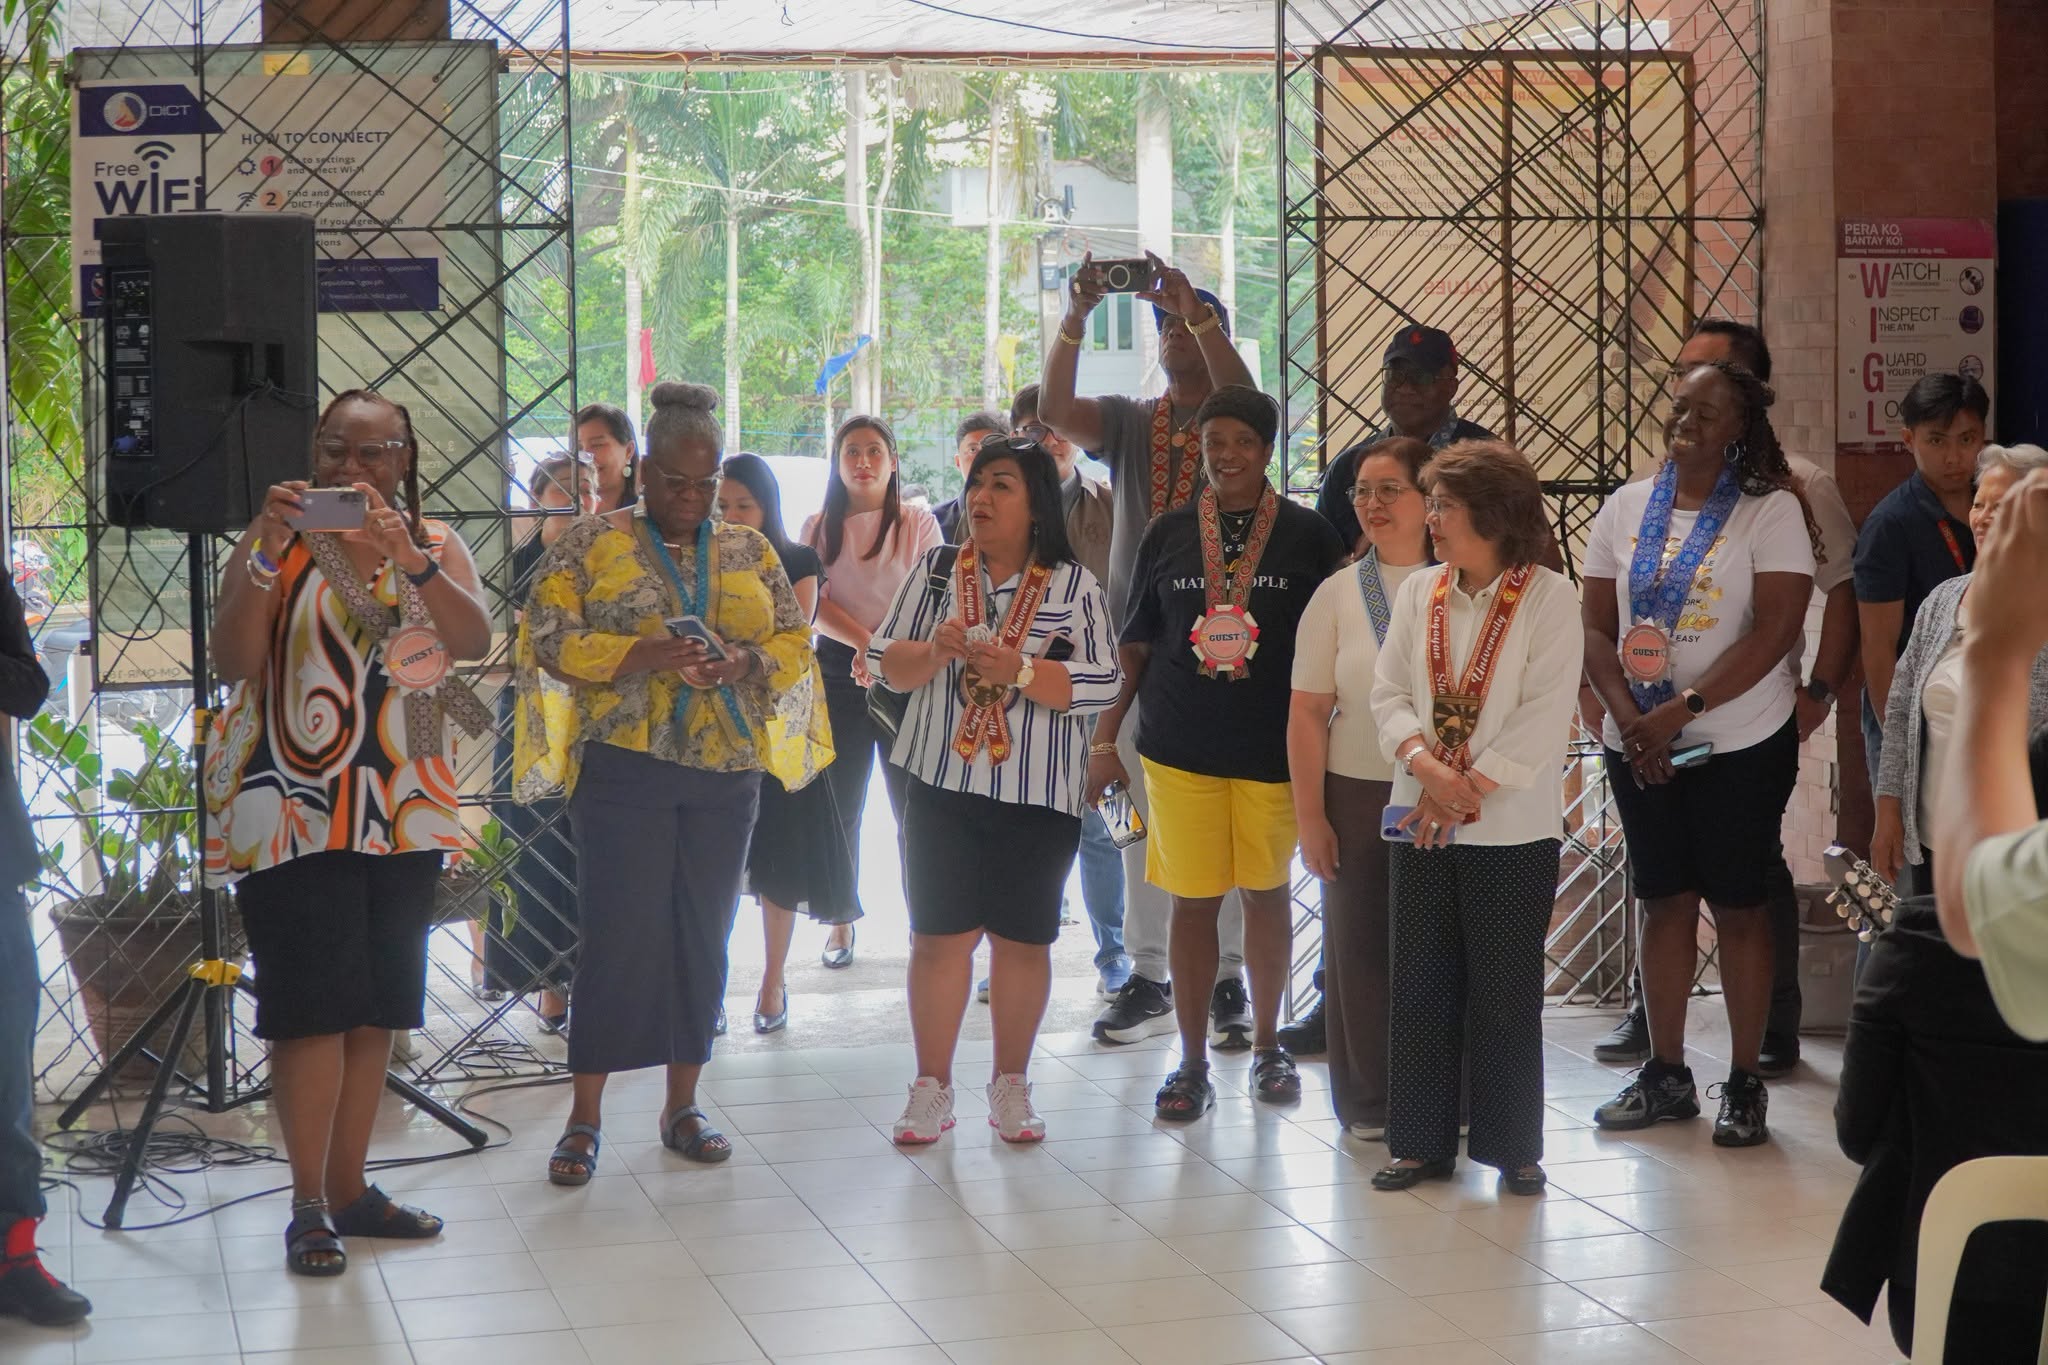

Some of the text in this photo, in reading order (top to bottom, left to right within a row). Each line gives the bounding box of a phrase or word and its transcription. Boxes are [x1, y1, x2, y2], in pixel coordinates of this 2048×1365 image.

[148, 104, 193, 117] DICT
[242, 131, 391, 145] HOW TO CONNECT?
[94, 162, 140, 179] Free
[94, 161, 205, 216] WiFi
[1845, 223, 1879, 236] PERA
[1845, 235, 1884, 246] BANTAY
[1860, 262, 1941, 299] WATCH
[1870, 306, 1942, 345] INSPECT
[1879, 323, 1916, 332] THE ATM
[1863, 352, 1928, 393] GUARD
[1887, 368, 1927, 377] YOUR PIN
[1173, 577, 1206, 591] MAT
[963, 574, 977, 621] Cagayan
[1007, 584, 1039, 639] University
[1209, 633, 1240, 642] GUEST
[1430, 604, 1445, 660] Cagayan
[1676, 634, 1701, 643] EASY
[400, 646, 434, 668] GUEST
[1471, 613, 1508, 684] University
[1632, 647, 1660, 658] GUEST
[1436, 672, 1448, 695] Sta
[965, 707, 983, 739] Caga
